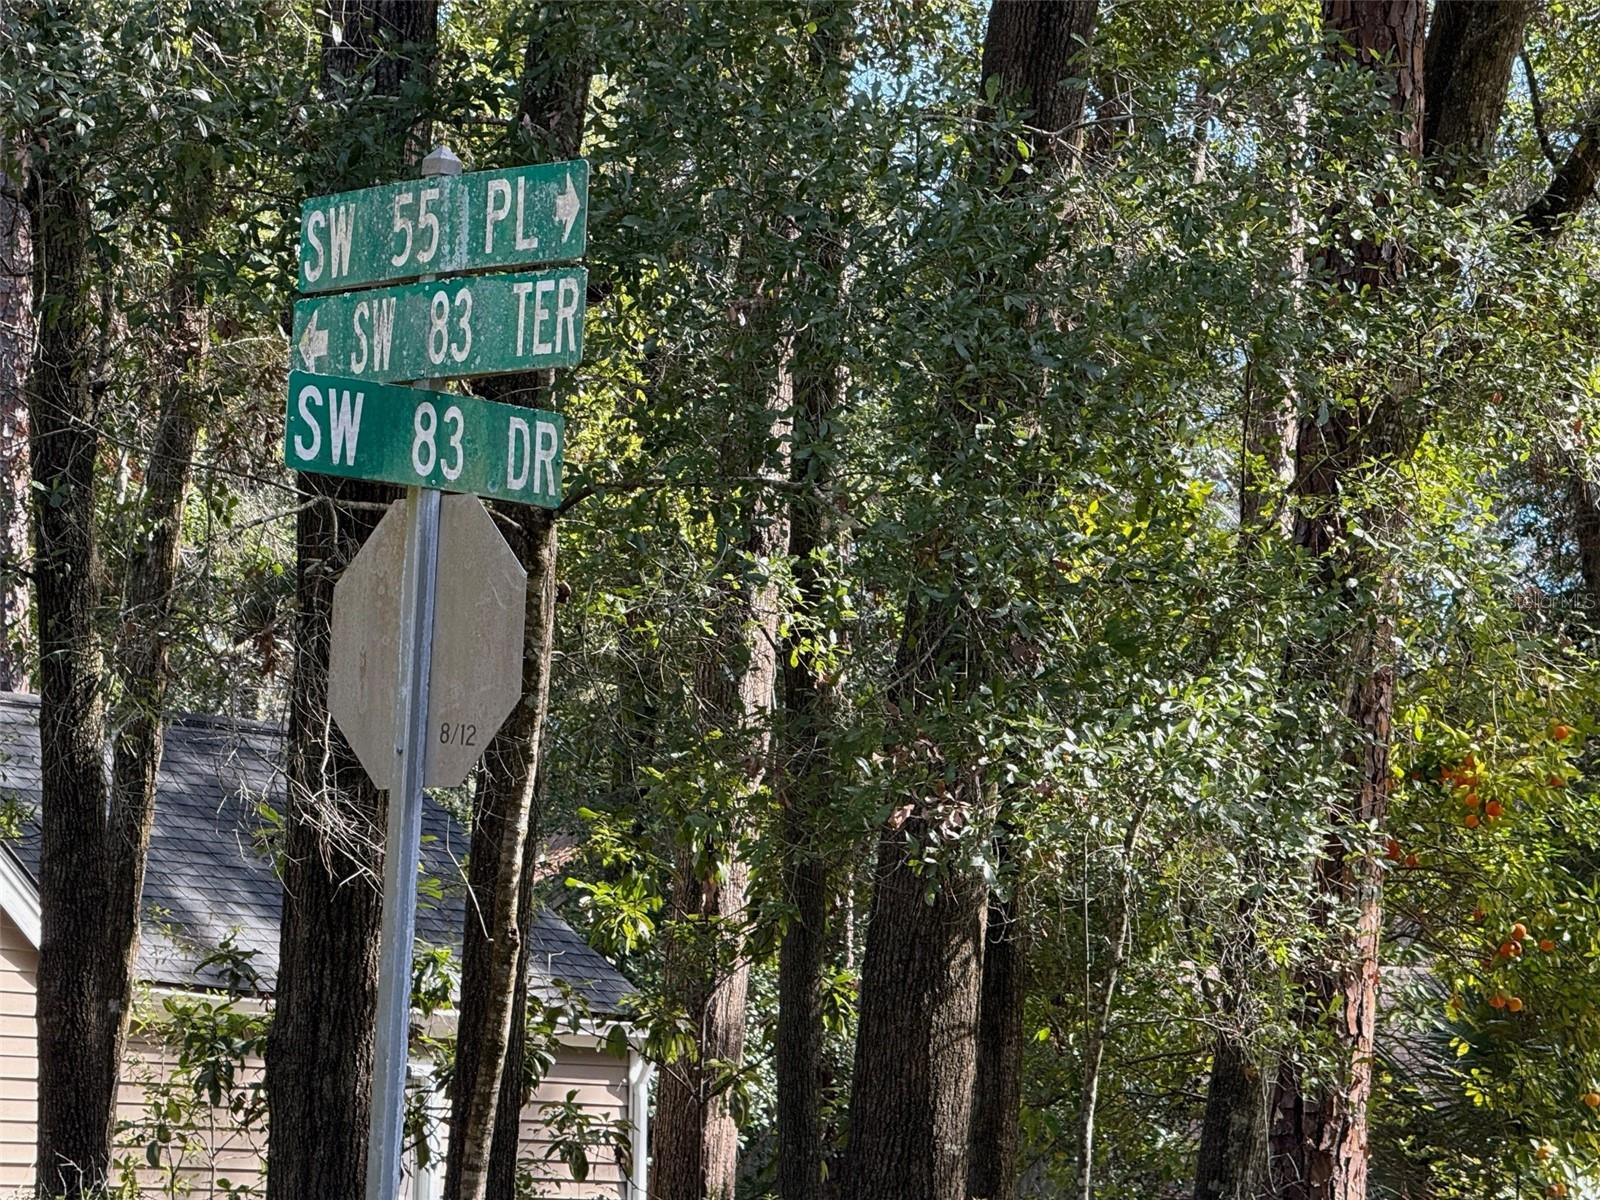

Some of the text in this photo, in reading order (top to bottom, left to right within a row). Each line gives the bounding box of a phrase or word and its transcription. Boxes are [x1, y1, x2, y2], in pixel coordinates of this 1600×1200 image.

[304, 176, 539, 282] SW 55 PL
[350, 277, 580, 374] SW 83 TER
[294, 384, 559, 496] SW 83 DR
[439, 723, 477, 746] 8/12
